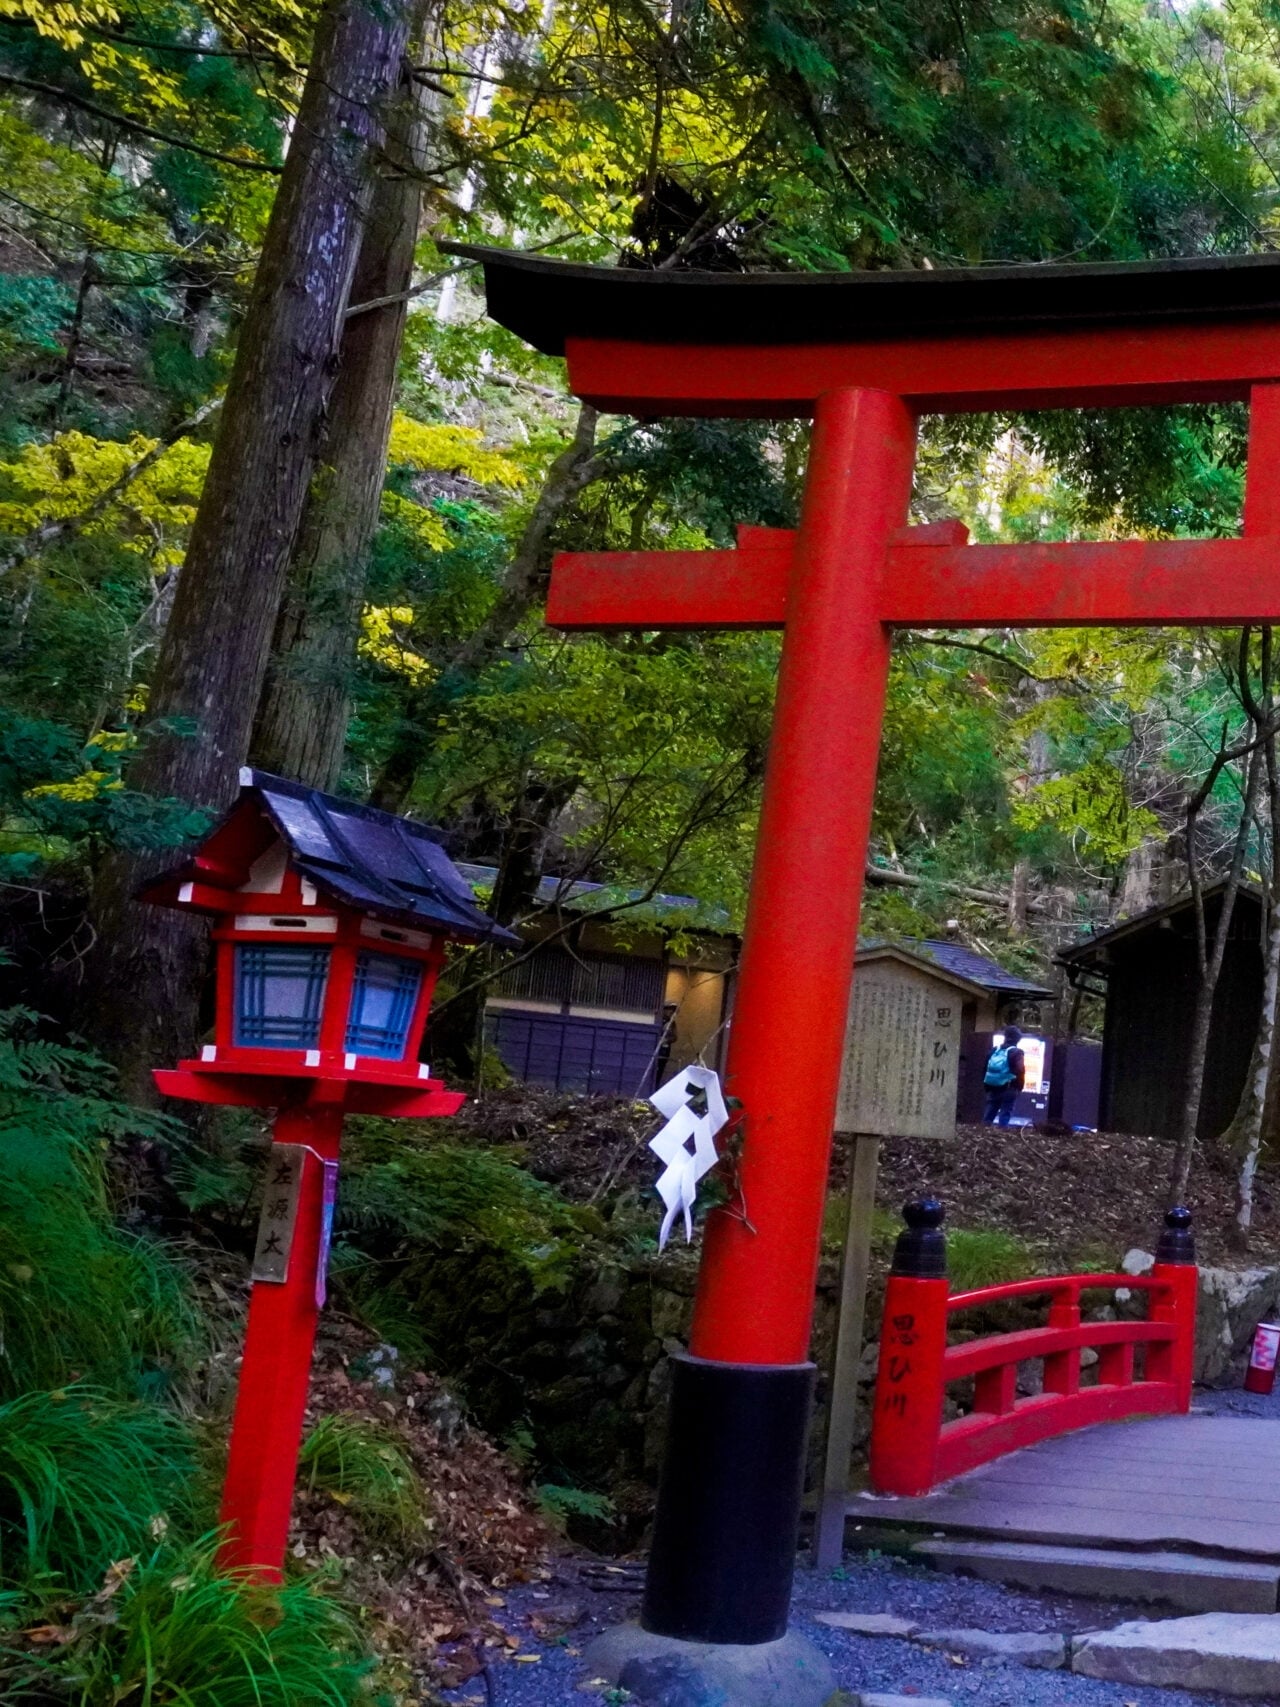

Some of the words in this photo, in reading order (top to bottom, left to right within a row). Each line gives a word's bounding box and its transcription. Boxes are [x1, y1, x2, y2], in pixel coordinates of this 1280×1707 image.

[929, 1007, 952, 1087] 思ひ川
[883, 1313, 920, 1417] 思ひ川
